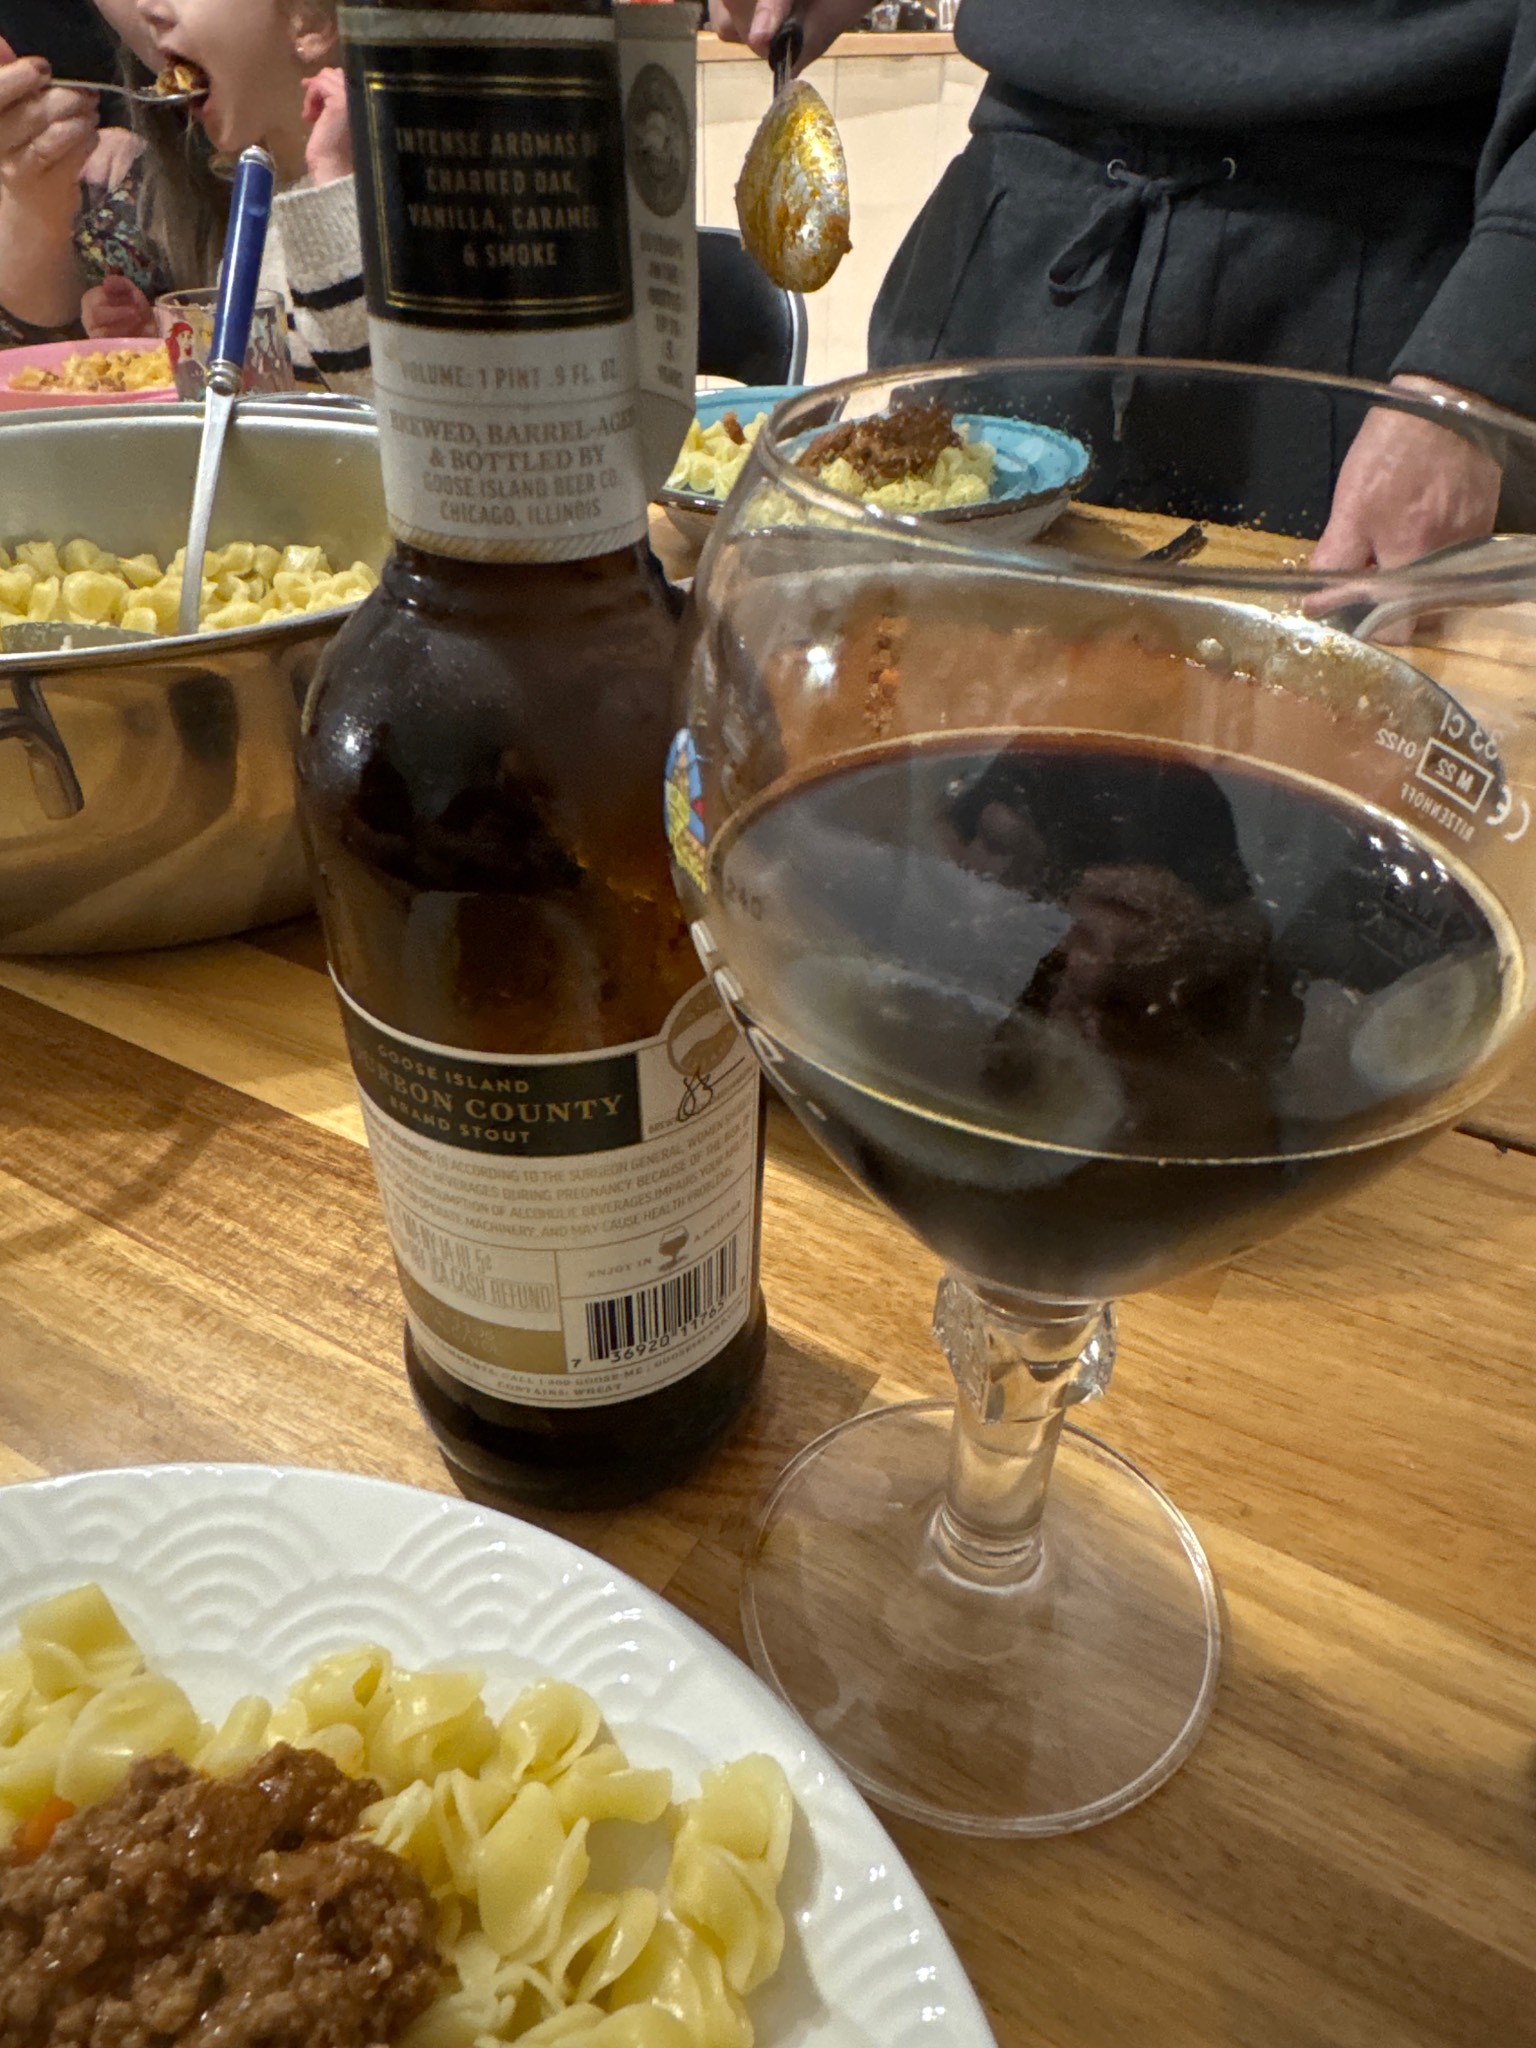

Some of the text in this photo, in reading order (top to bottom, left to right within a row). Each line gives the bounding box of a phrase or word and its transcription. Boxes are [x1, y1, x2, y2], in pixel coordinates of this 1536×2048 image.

[395, 128, 480, 156] INTENSE
[487, 243, 557, 268] SMOKE
[494, 366, 540, 389] PINT
[451, 448, 572, 472] BOTTLED
[577, 443, 606, 464] BY
[528, 499, 601, 526] ILLINOIS
[377, 1044, 529, 1093] GOOSE ISLAND
[465, 1094, 622, 1123] COUNTY
[459, 1124, 530, 1144] STOUT
[557, 1180, 632, 1200] PREGNANCY
[636, 1161, 686, 1187] BECAUSE
[582, 1189, 650, 1217] BEVERAGES
[490, 1279, 552, 1312] REFUND
[571, 1358, 582, 1369] 7
[610, 1335, 670, 1363] 36920
